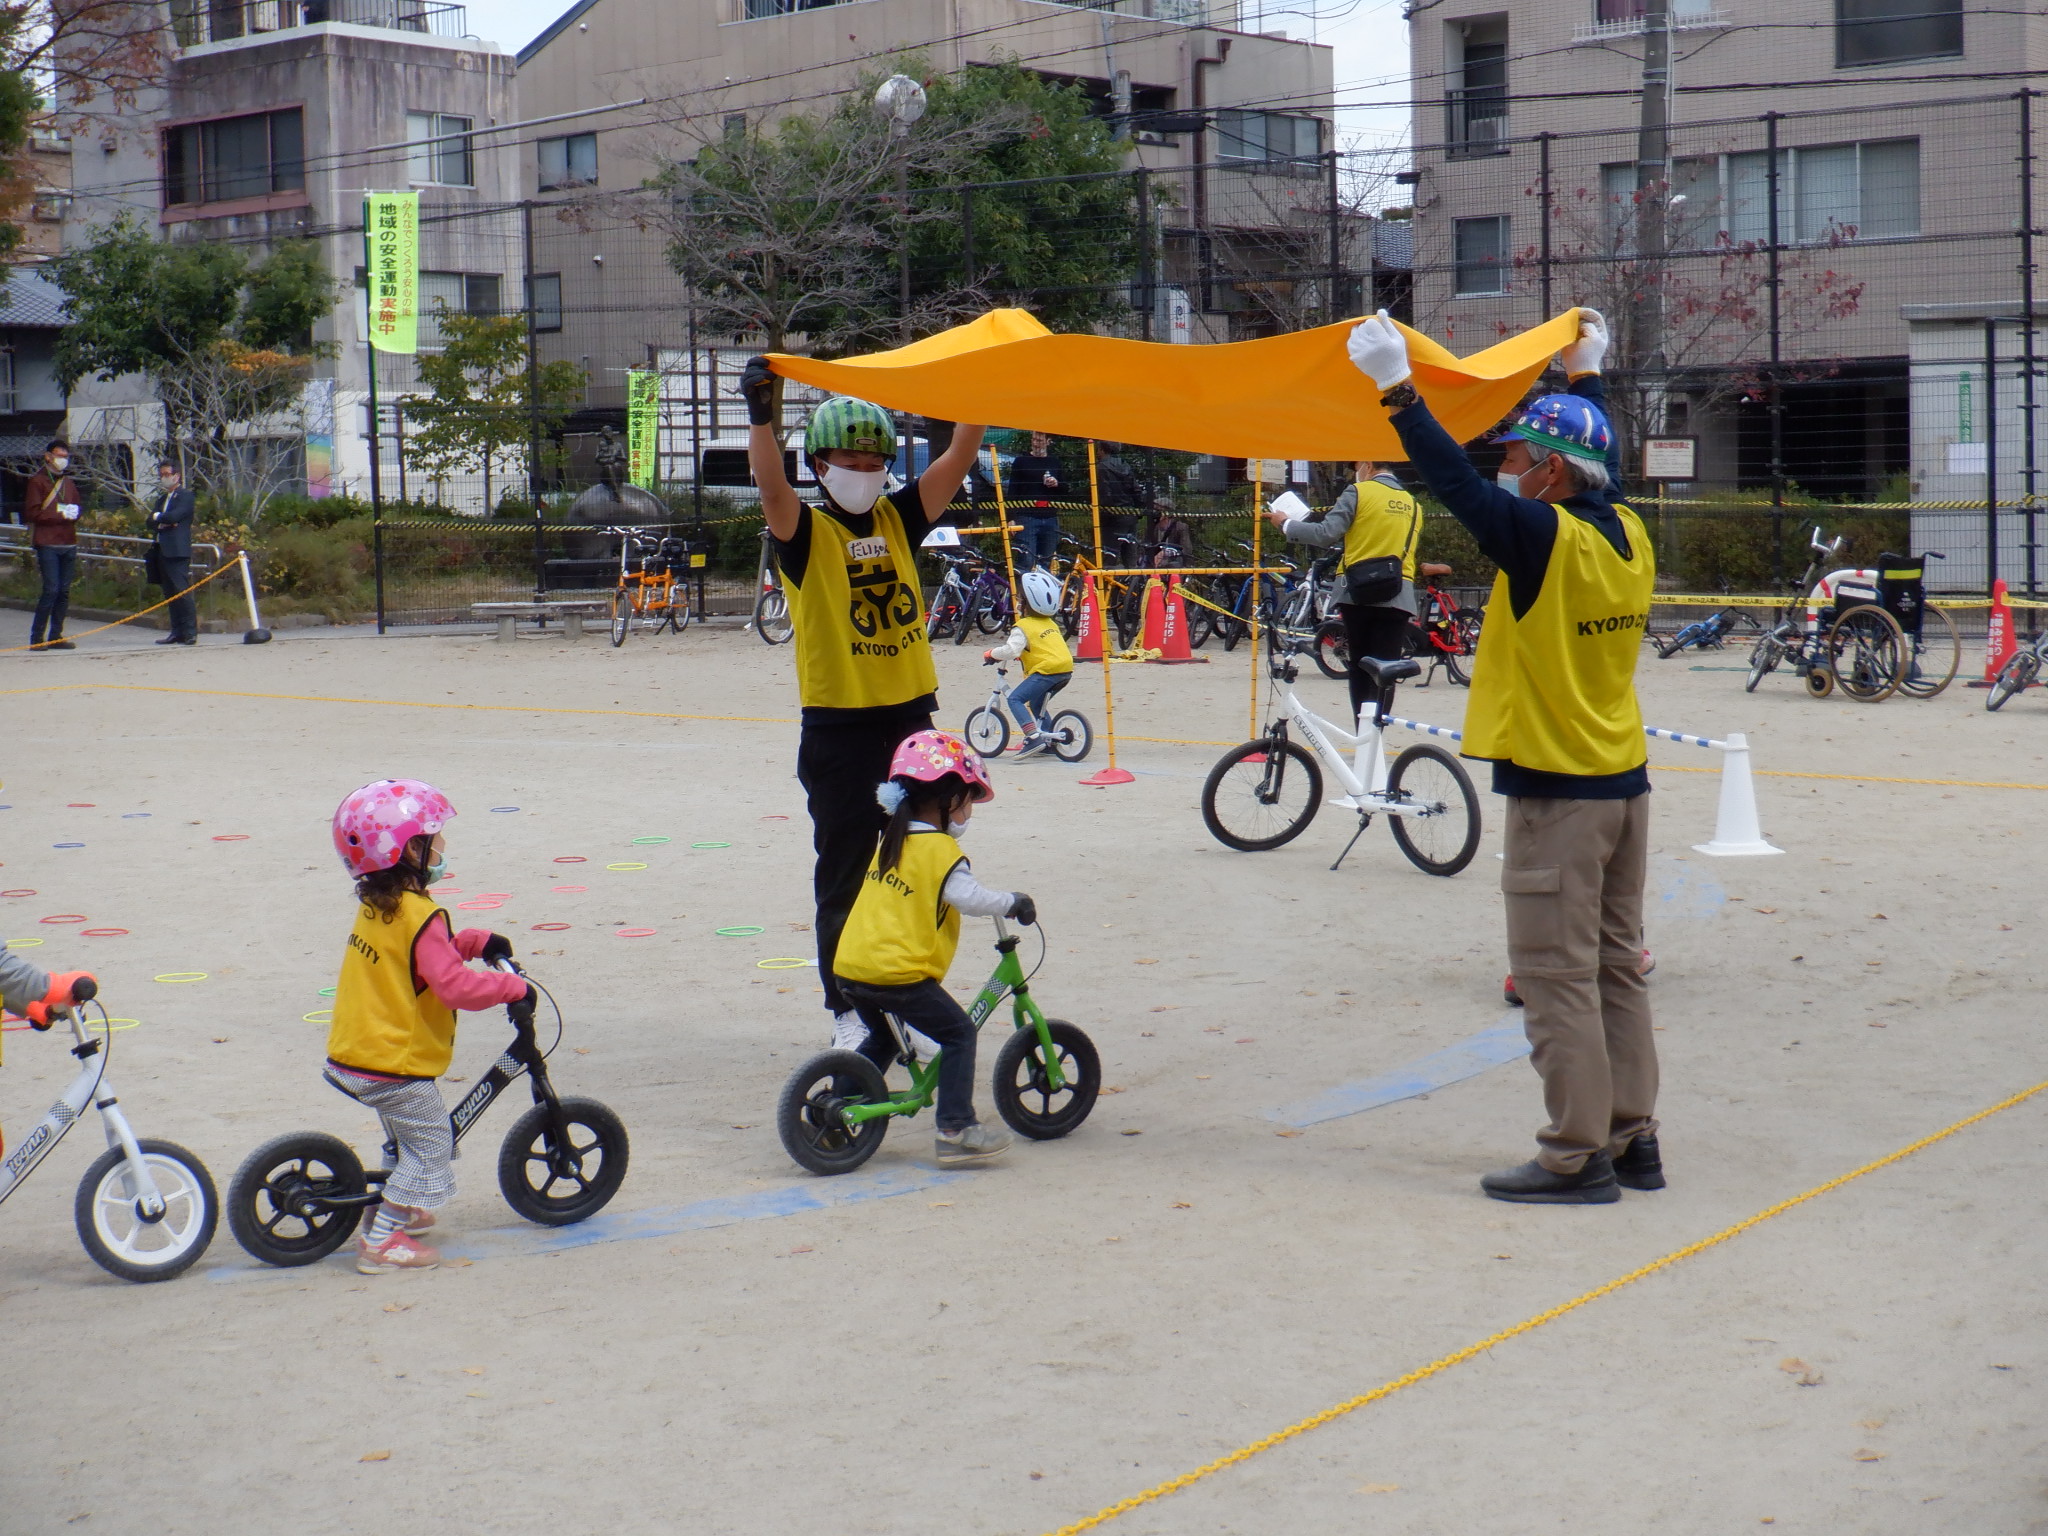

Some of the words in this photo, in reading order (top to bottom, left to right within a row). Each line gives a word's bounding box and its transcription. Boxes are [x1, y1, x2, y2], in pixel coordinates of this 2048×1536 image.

[379, 202, 398, 336] 地域の安全運動実施中
[1577, 614, 1635, 636] KYOTO
[851, 641, 899, 658] KYOTO
[901, 627, 923, 650] CIT
[886, 873, 915, 897] CITY
